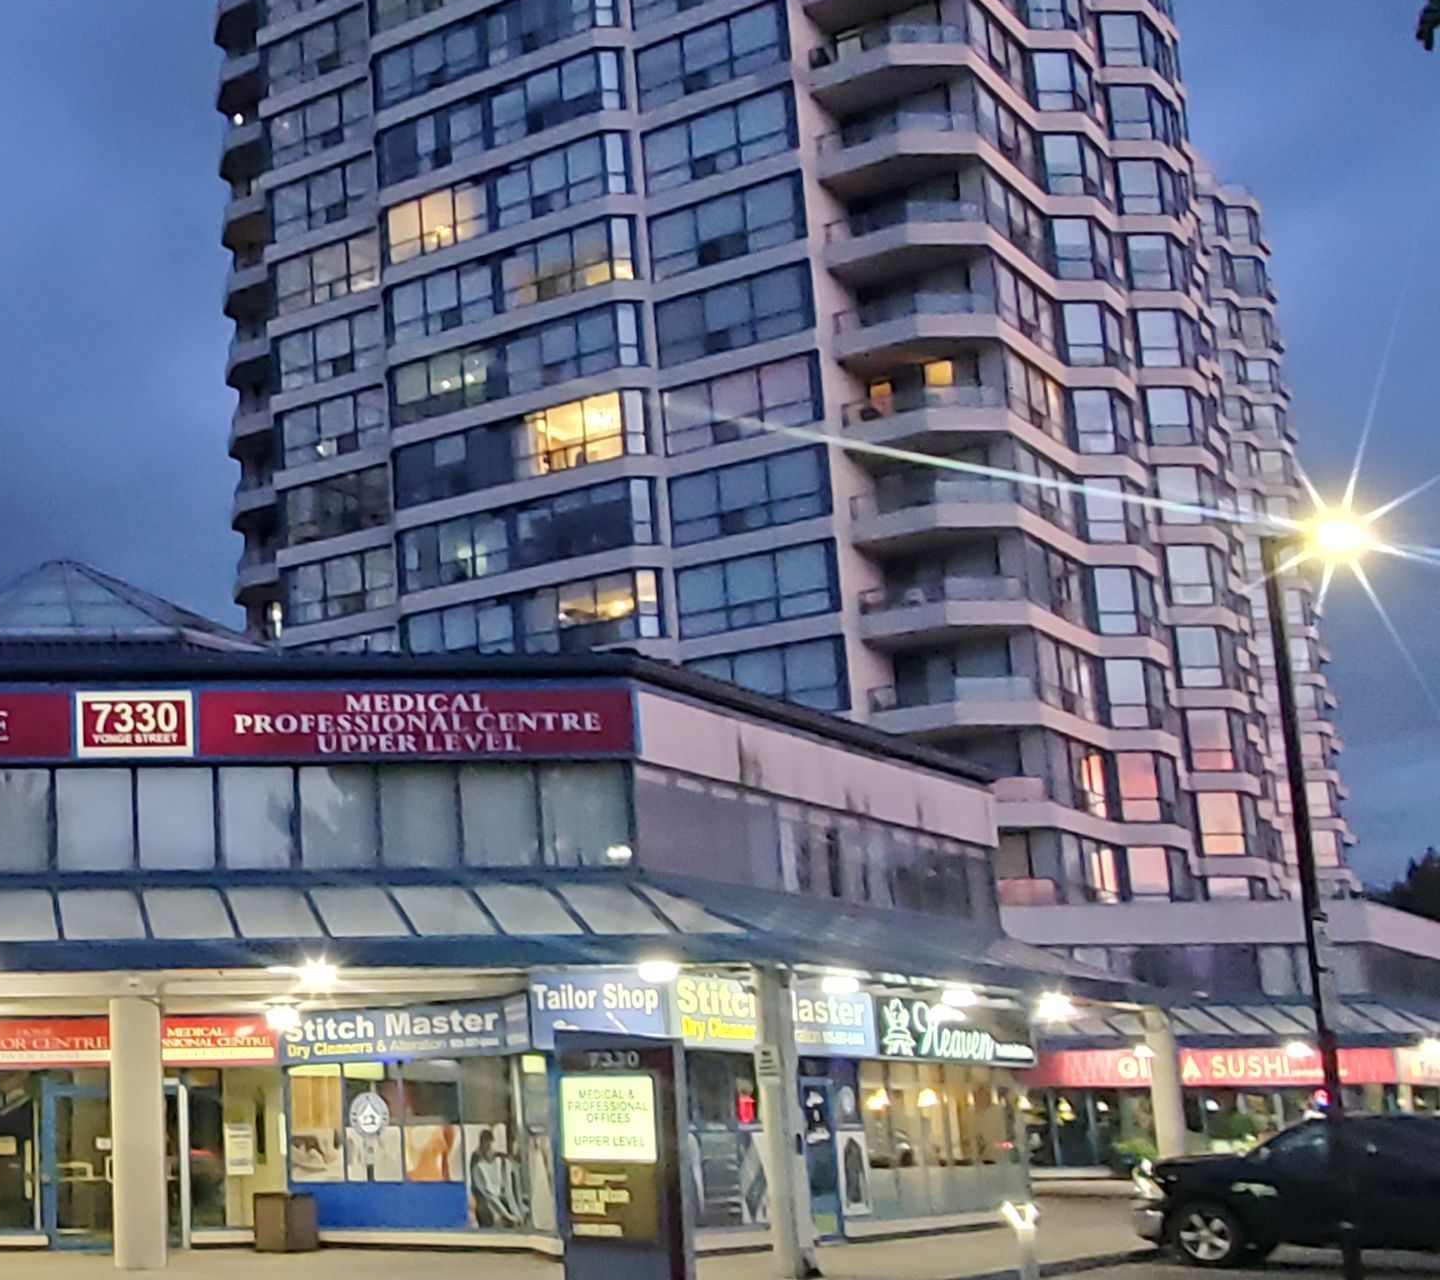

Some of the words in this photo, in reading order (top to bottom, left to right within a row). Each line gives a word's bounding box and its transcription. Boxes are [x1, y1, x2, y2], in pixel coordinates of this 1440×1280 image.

[345, 693, 488, 713] MEDICAL
[90, 702, 178, 733] 7330
[233, 713, 463, 734] PROFESSIONAL
[476, 712, 601, 732] CENTRE
[134, 733, 178, 744] STREET
[317, 733, 417, 754] UPPER
[425, 732, 521, 753] LEVEL
[532, 983, 598, 1011] Tailor
[603, 982, 659, 1016] Shop
[166, 1027, 225, 1038] MEDICAL
[284, 1015, 375, 1043] Stitch
[385, 1009, 500, 1037] Master
[287, 1043, 311, 1060] Dry
[376, 1039, 387, 1052] &
[1211, 1054, 1290, 1079] SUSHI
[578, 1088, 624, 1100] MEDICAL
[567, 1100, 649, 1112] PROFESSIONAL
[586, 1112, 631, 1124] OFFICES
[573, 1135, 611, 1147] UPPER
[612, 1135, 646, 1147] LEVEL
